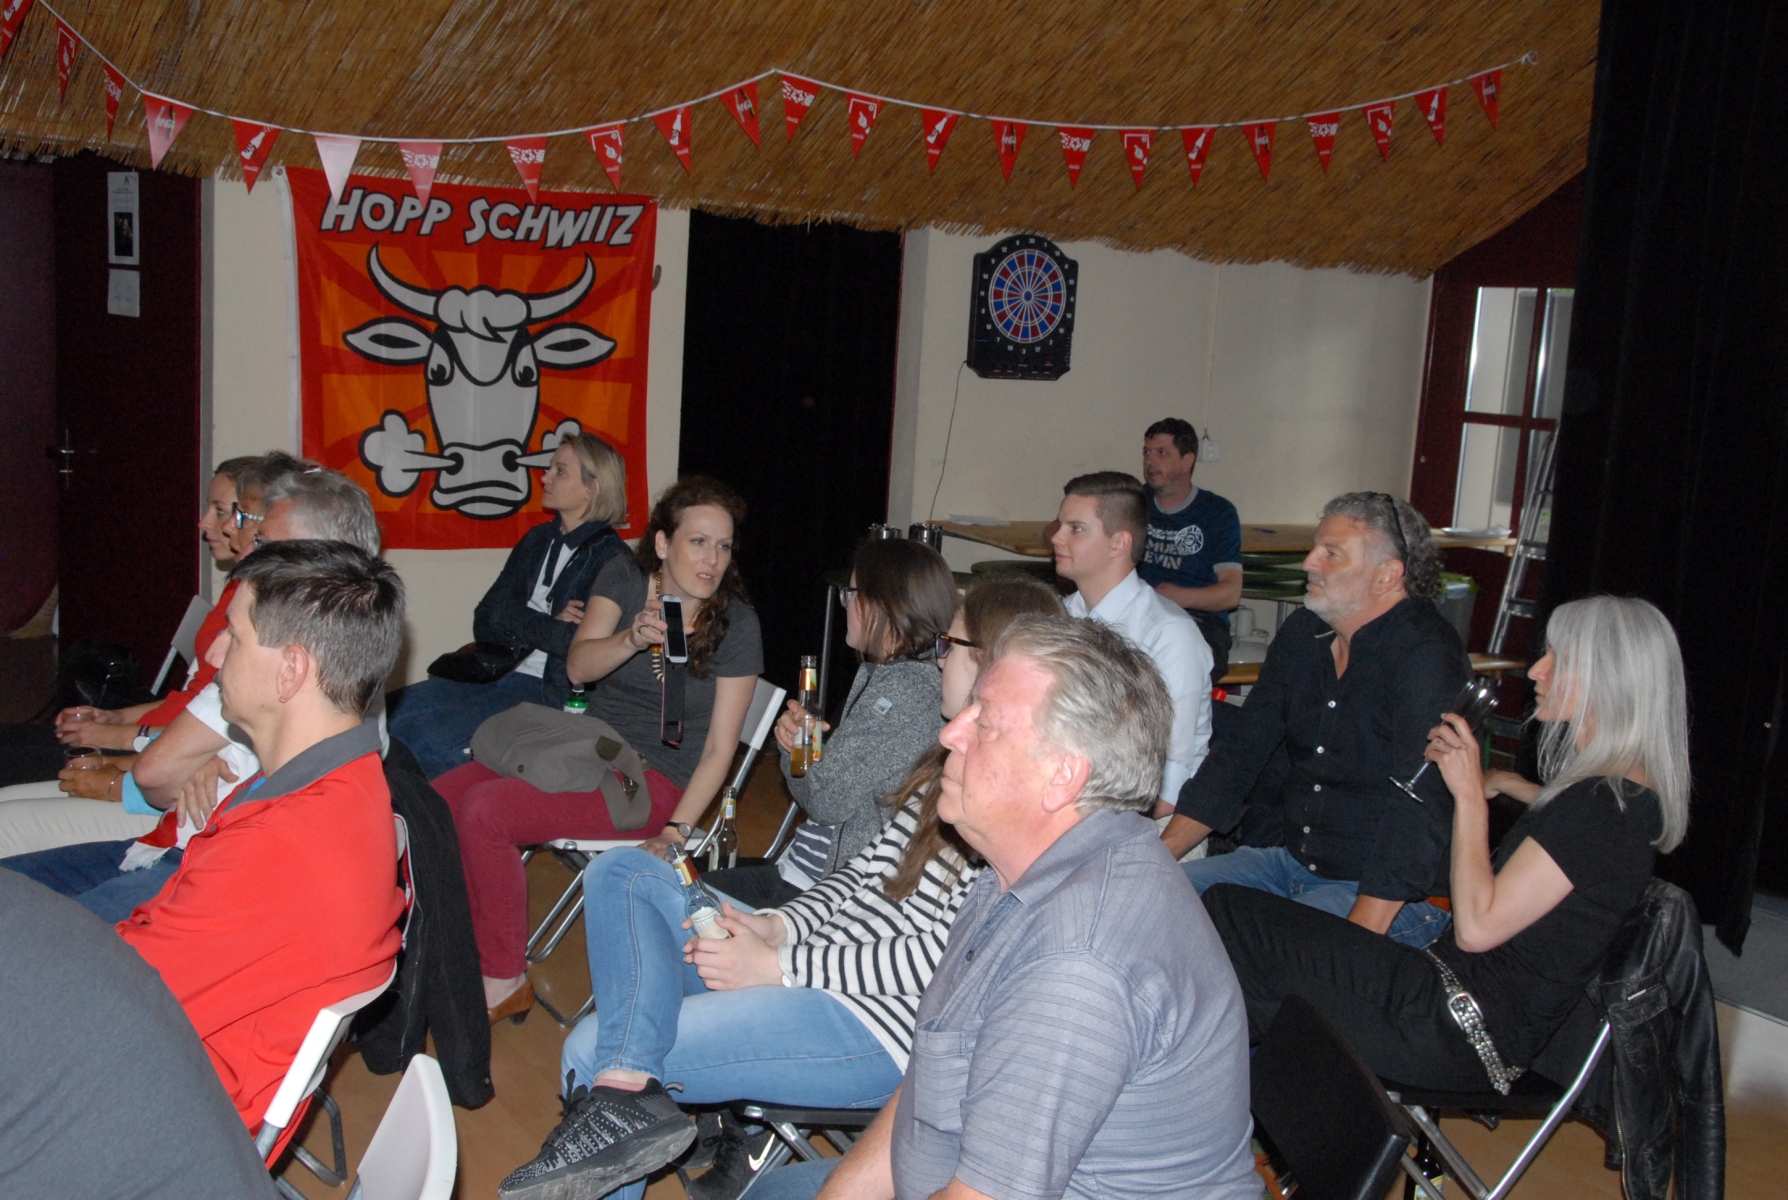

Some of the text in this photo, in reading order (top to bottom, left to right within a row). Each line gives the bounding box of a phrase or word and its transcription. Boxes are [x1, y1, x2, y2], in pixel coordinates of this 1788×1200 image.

[320, 186, 645, 250] HOPP SCHWIIZ
[1145, 538, 1189, 556] MUEL
[1143, 550, 1182, 570] EVIN
